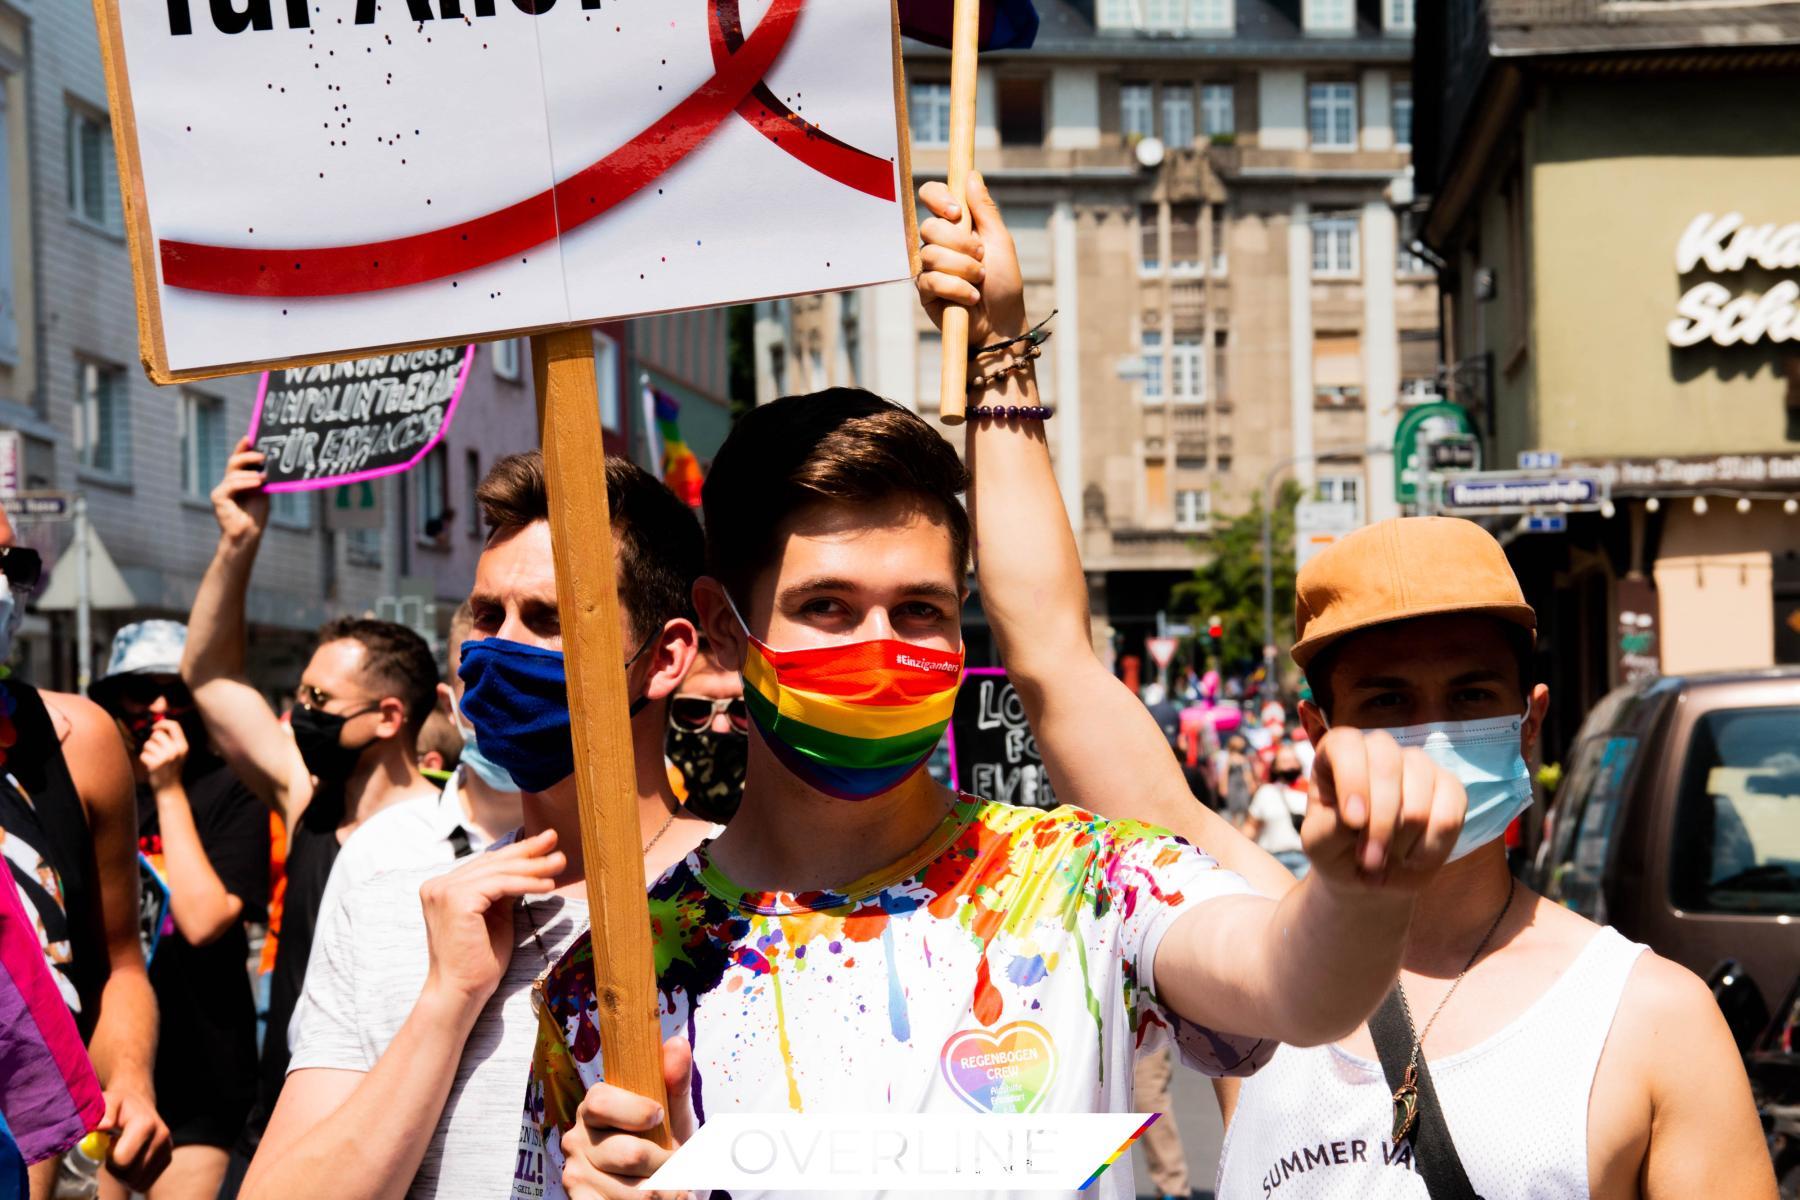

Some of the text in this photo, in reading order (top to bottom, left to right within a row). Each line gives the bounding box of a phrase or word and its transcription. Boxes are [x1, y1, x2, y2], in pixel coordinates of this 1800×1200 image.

[896, 654, 959, 672] #Einziganders
[960, 1047, 1038, 1069] REGENBOGEN
[986, 1065, 1019, 1080] CREW
[1262, 1139, 1367, 1199] SUMMER
